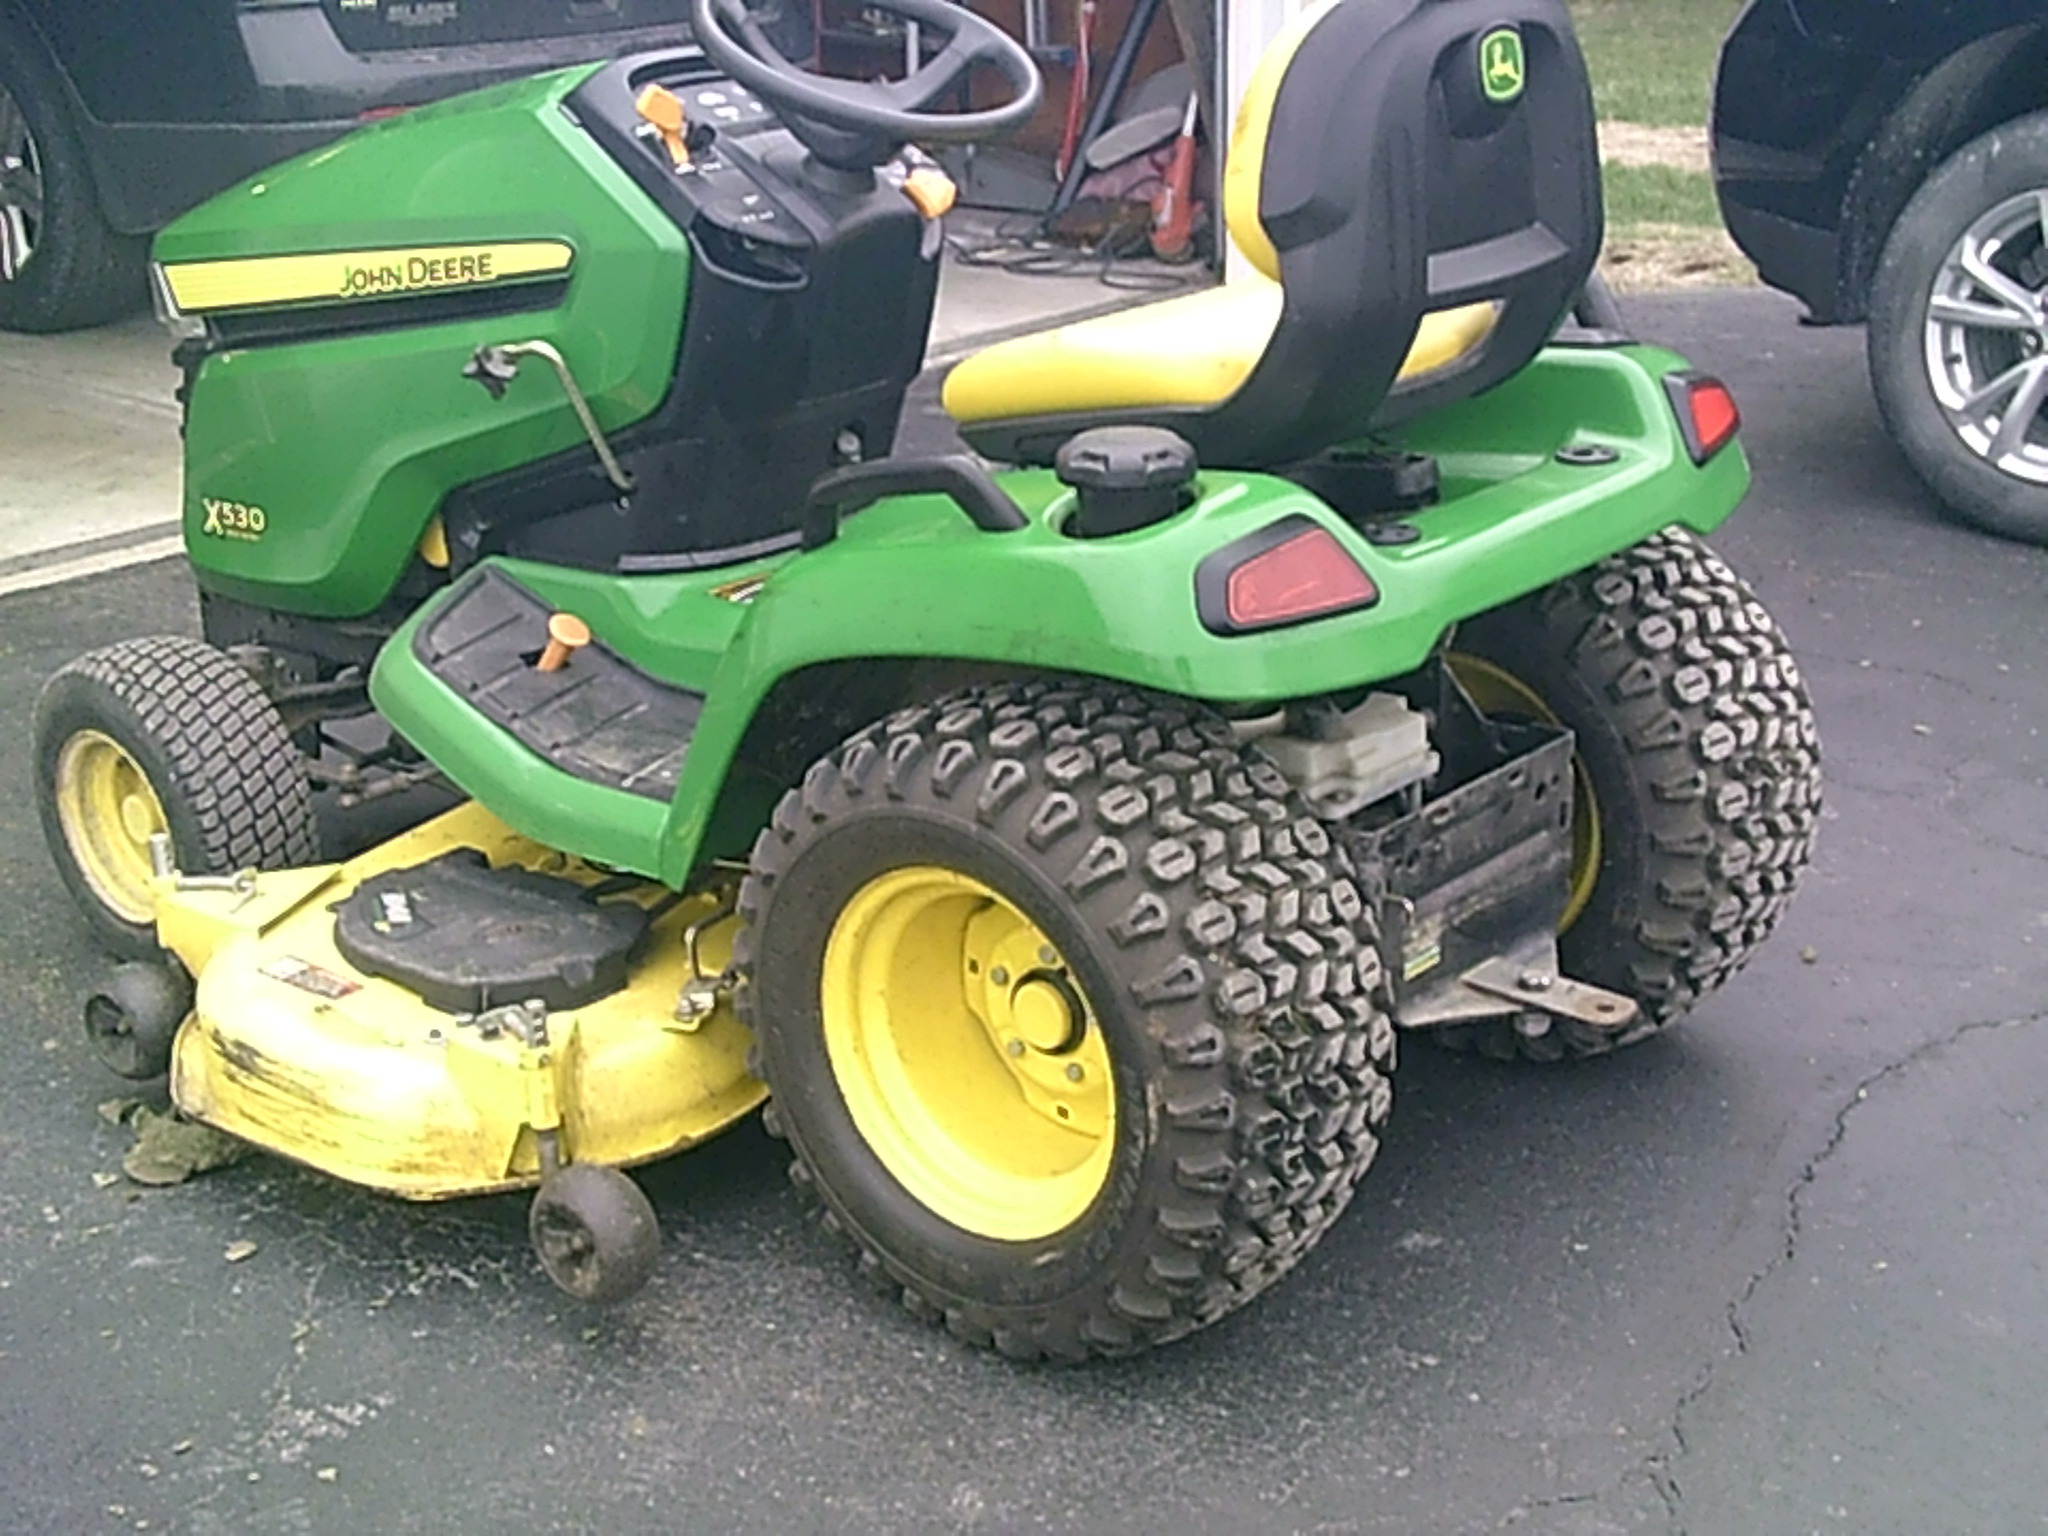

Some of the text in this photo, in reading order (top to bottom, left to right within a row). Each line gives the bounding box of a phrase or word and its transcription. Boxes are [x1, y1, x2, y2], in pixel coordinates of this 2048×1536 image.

[340, 253, 493, 292] JOHN DEERE
[203, 498, 265, 535] X530
